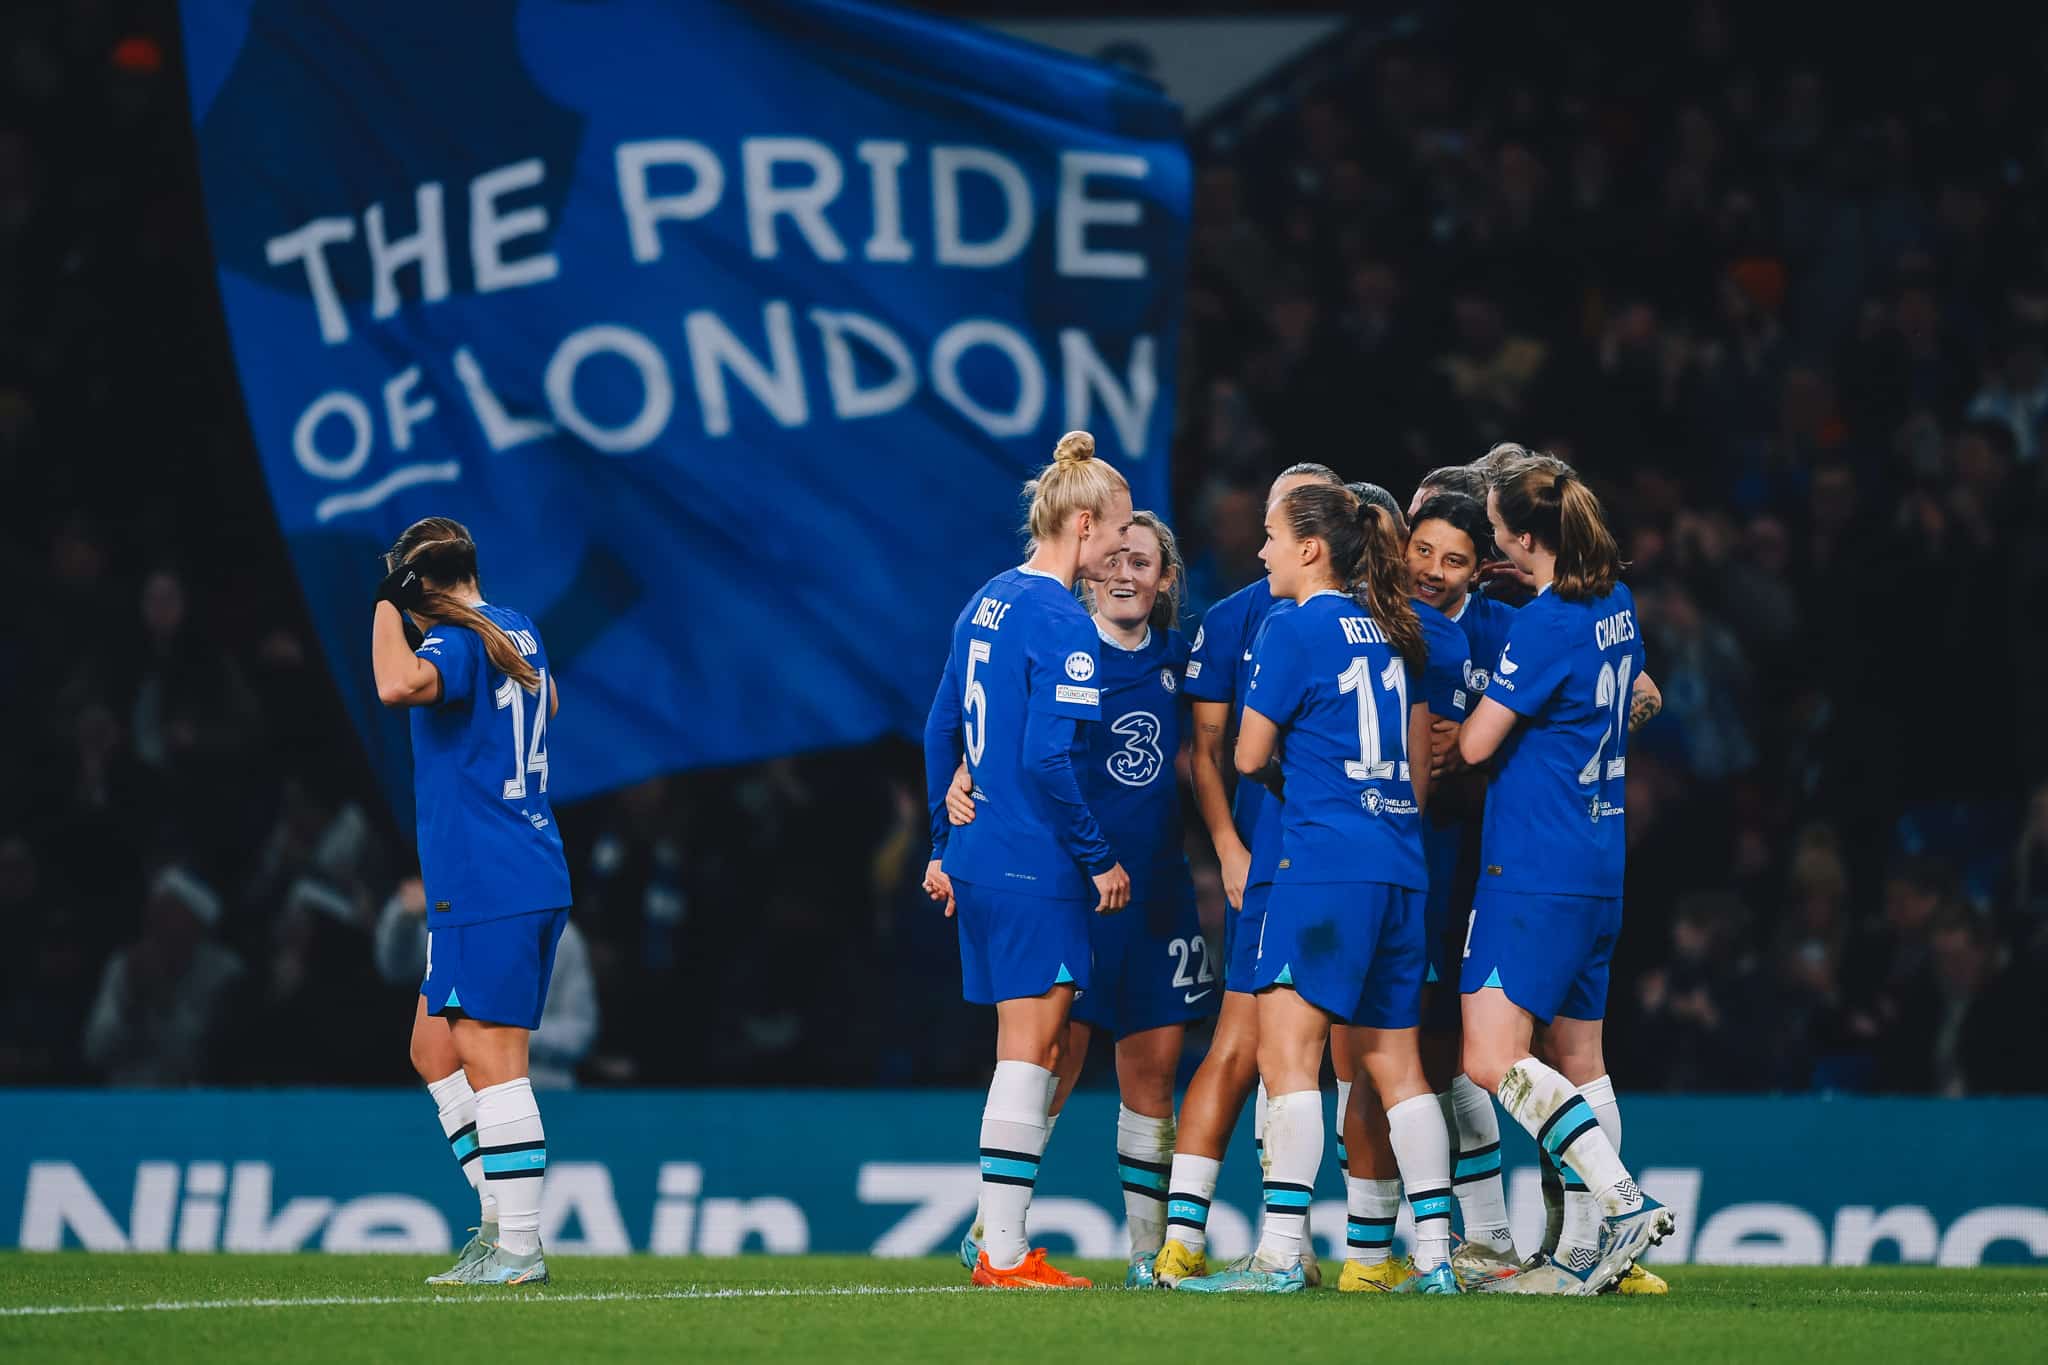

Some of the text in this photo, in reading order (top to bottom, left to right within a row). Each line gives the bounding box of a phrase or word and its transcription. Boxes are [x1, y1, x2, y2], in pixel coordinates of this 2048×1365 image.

[266, 136, 1150, 343] THE PRIDE
[292, 302, 1157, 480] OF LONDON
[495, 667, 548, 800] 14
[963, 638, 992, 769] 5
[1337, 656, 1412, 782] 11
[1578, 654, 1633, 785] 21
[1168, 935, 1214, 988] 22
[20, 1161, 452, 1254] Nike
[1173, 1204, 1197, 1216] CFC
[1423, 1200, 1446, 1211] CFC
